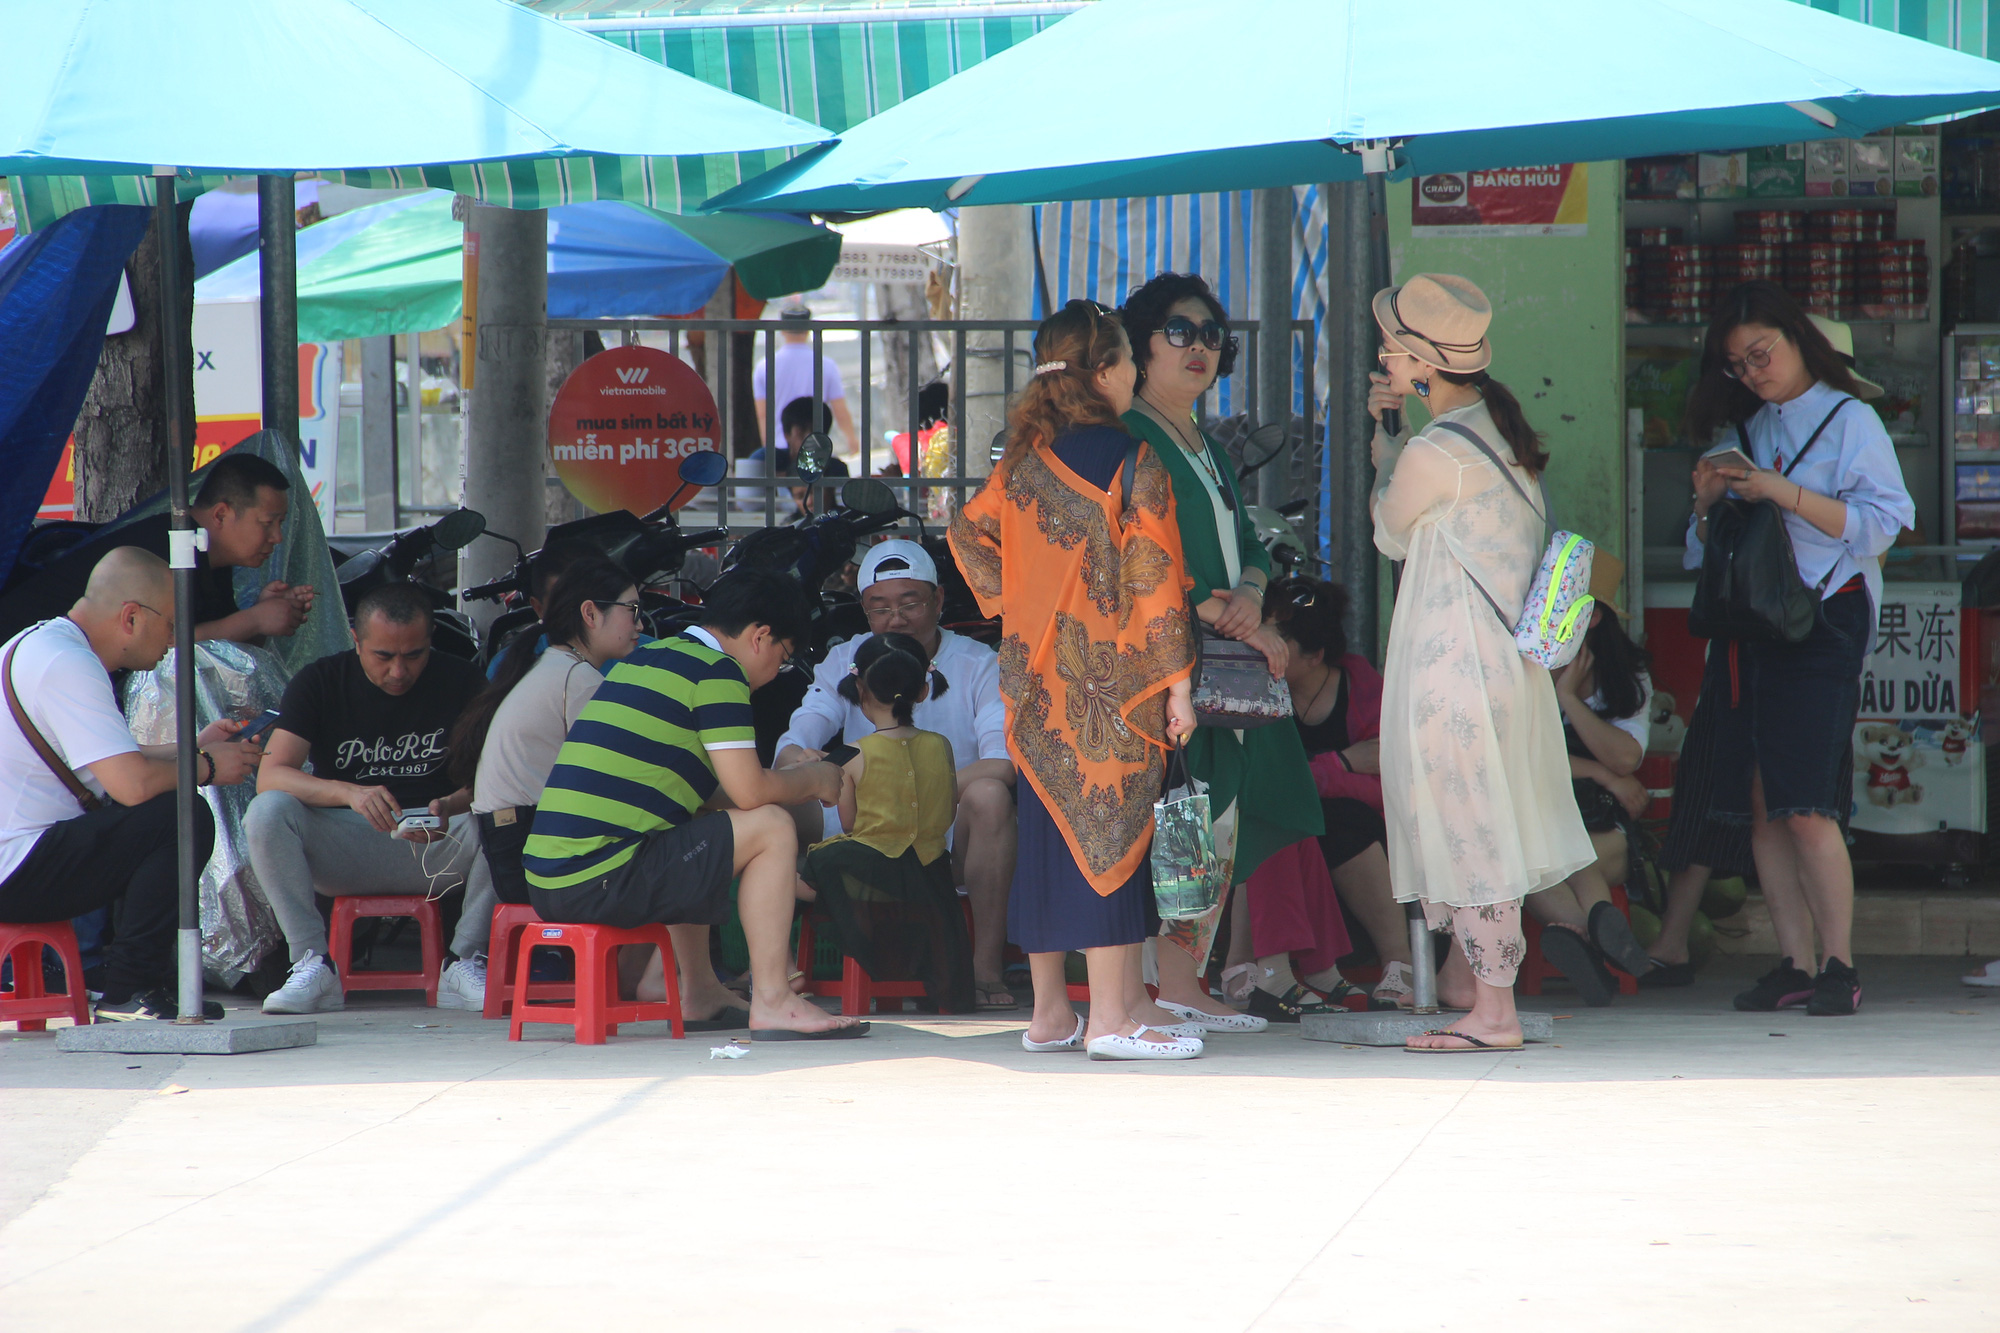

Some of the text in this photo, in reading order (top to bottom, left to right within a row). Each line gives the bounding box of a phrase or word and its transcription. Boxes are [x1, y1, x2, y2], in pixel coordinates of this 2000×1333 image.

[1425, 185, 1461, 193] CRAVEN
[600, 386, 667, 396] vietnamobile
[576, 417, 617, 430] mua
[621, 413, 652, 430] sim
[657, 411, 688, 429] bất
[553, 433, 614, 460] miễn
[620, 438, 659, 465] phí
[1874, 603, 1955, 663] 果冻
[1860, 671, 1956, 713] ÂU DỪA
[335, 737, 393, 769] Polo
[400, 763, 427, 775] 1967
